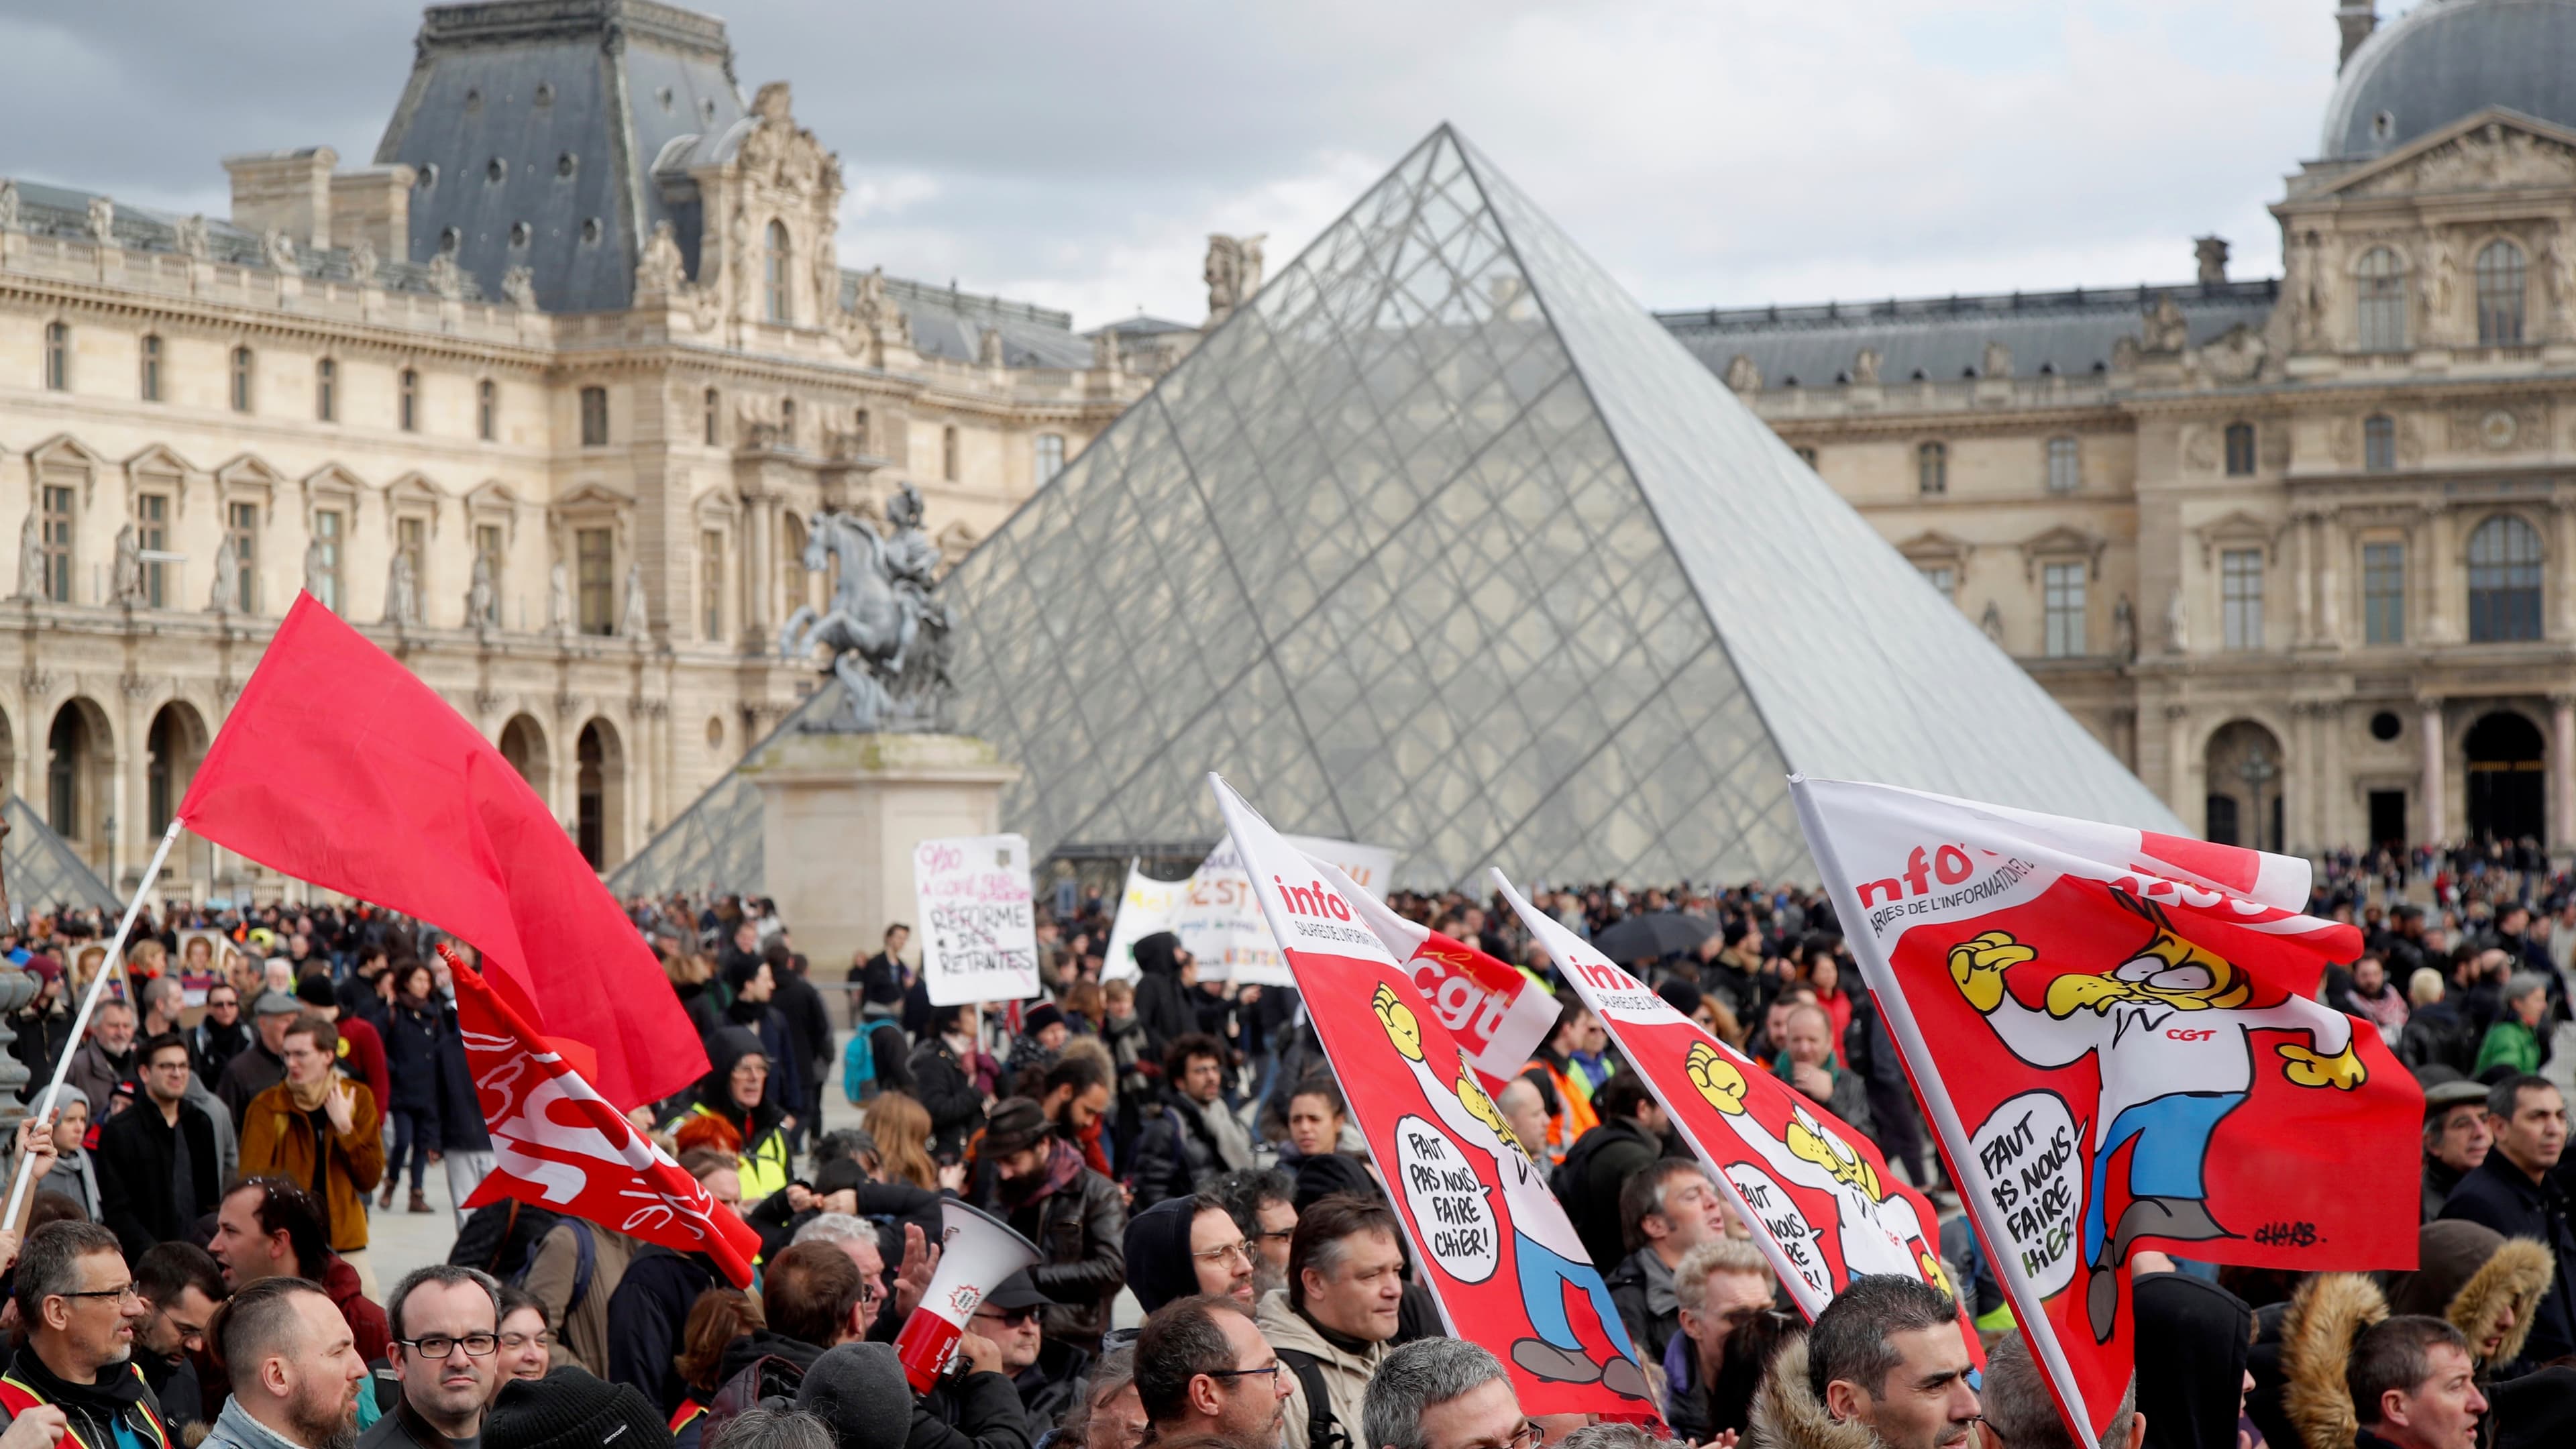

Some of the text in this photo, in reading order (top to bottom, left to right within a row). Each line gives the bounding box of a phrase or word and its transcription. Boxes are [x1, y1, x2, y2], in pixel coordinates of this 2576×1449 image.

[1870, 905, 1904, 939] ARIES
[1908, 900, 1929, 915] DE
[1931, 863, 2023, 910] L'INFORMATION
[1295, 920, 1330, 938] SALARIES
[1326, 924, 1340, 941] DE
[1407, 957, 1509, 1041] cgt
[1596, 994, 1633, 1010] SALARIES
[1628, 996, 1646, 1010] DE
[2165, 1028, 2217, 1042] CGT
[1407, 1132, 1446, 1161] FAUT
[1980, 1110, 2035, 1180] FAUT
[1409, 1163, 1478, 1195] PAS NOUS
[1991, 1125, 2072, 1214] AS NOUS
[1765, 1213, 1805, 1239] NOUS
